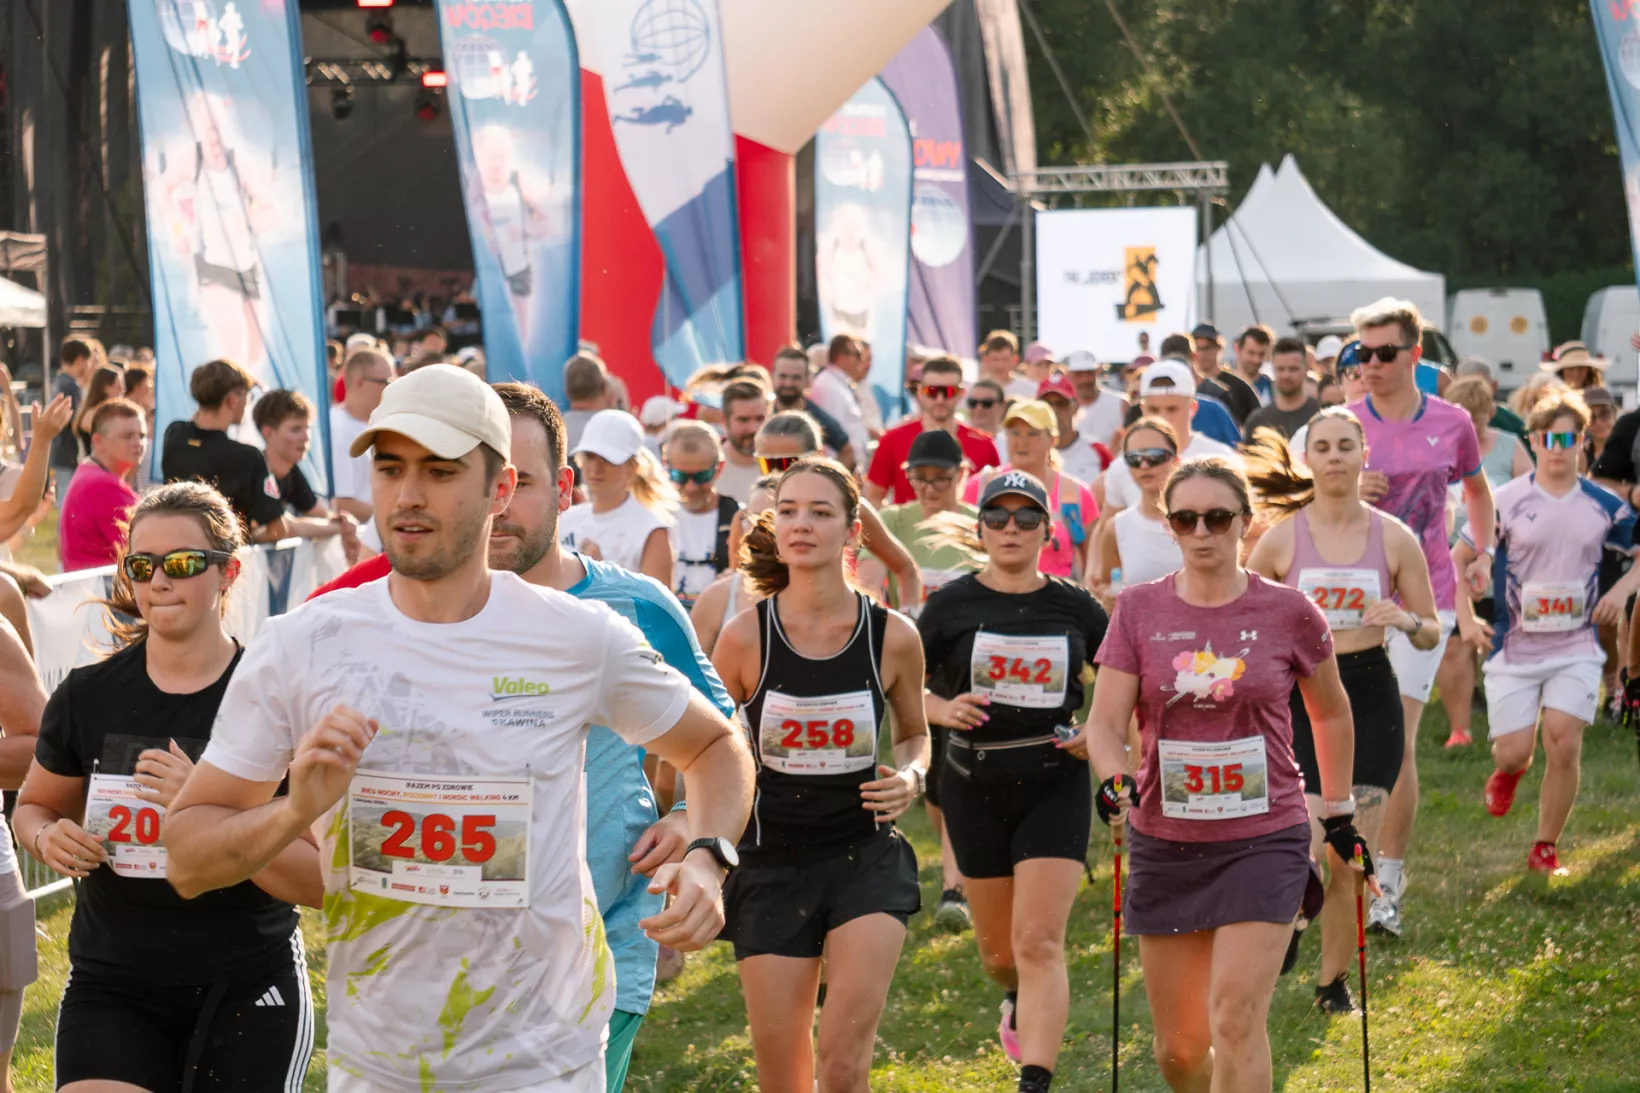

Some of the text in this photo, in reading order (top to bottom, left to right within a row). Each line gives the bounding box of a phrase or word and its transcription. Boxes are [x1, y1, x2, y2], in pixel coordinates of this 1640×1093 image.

[1312, 587, 1365, 609] 272
[1537, 596, 1573, 615] 341
[988, 655, 1052, 684] 342
[492, 676, 550, 695] Valeo
[781, 718, 854, 748] 258
[1183, 763, 1244, 793] 315
[108, 805, 160, 845] 20
[380, 810, 497, 863] 265
